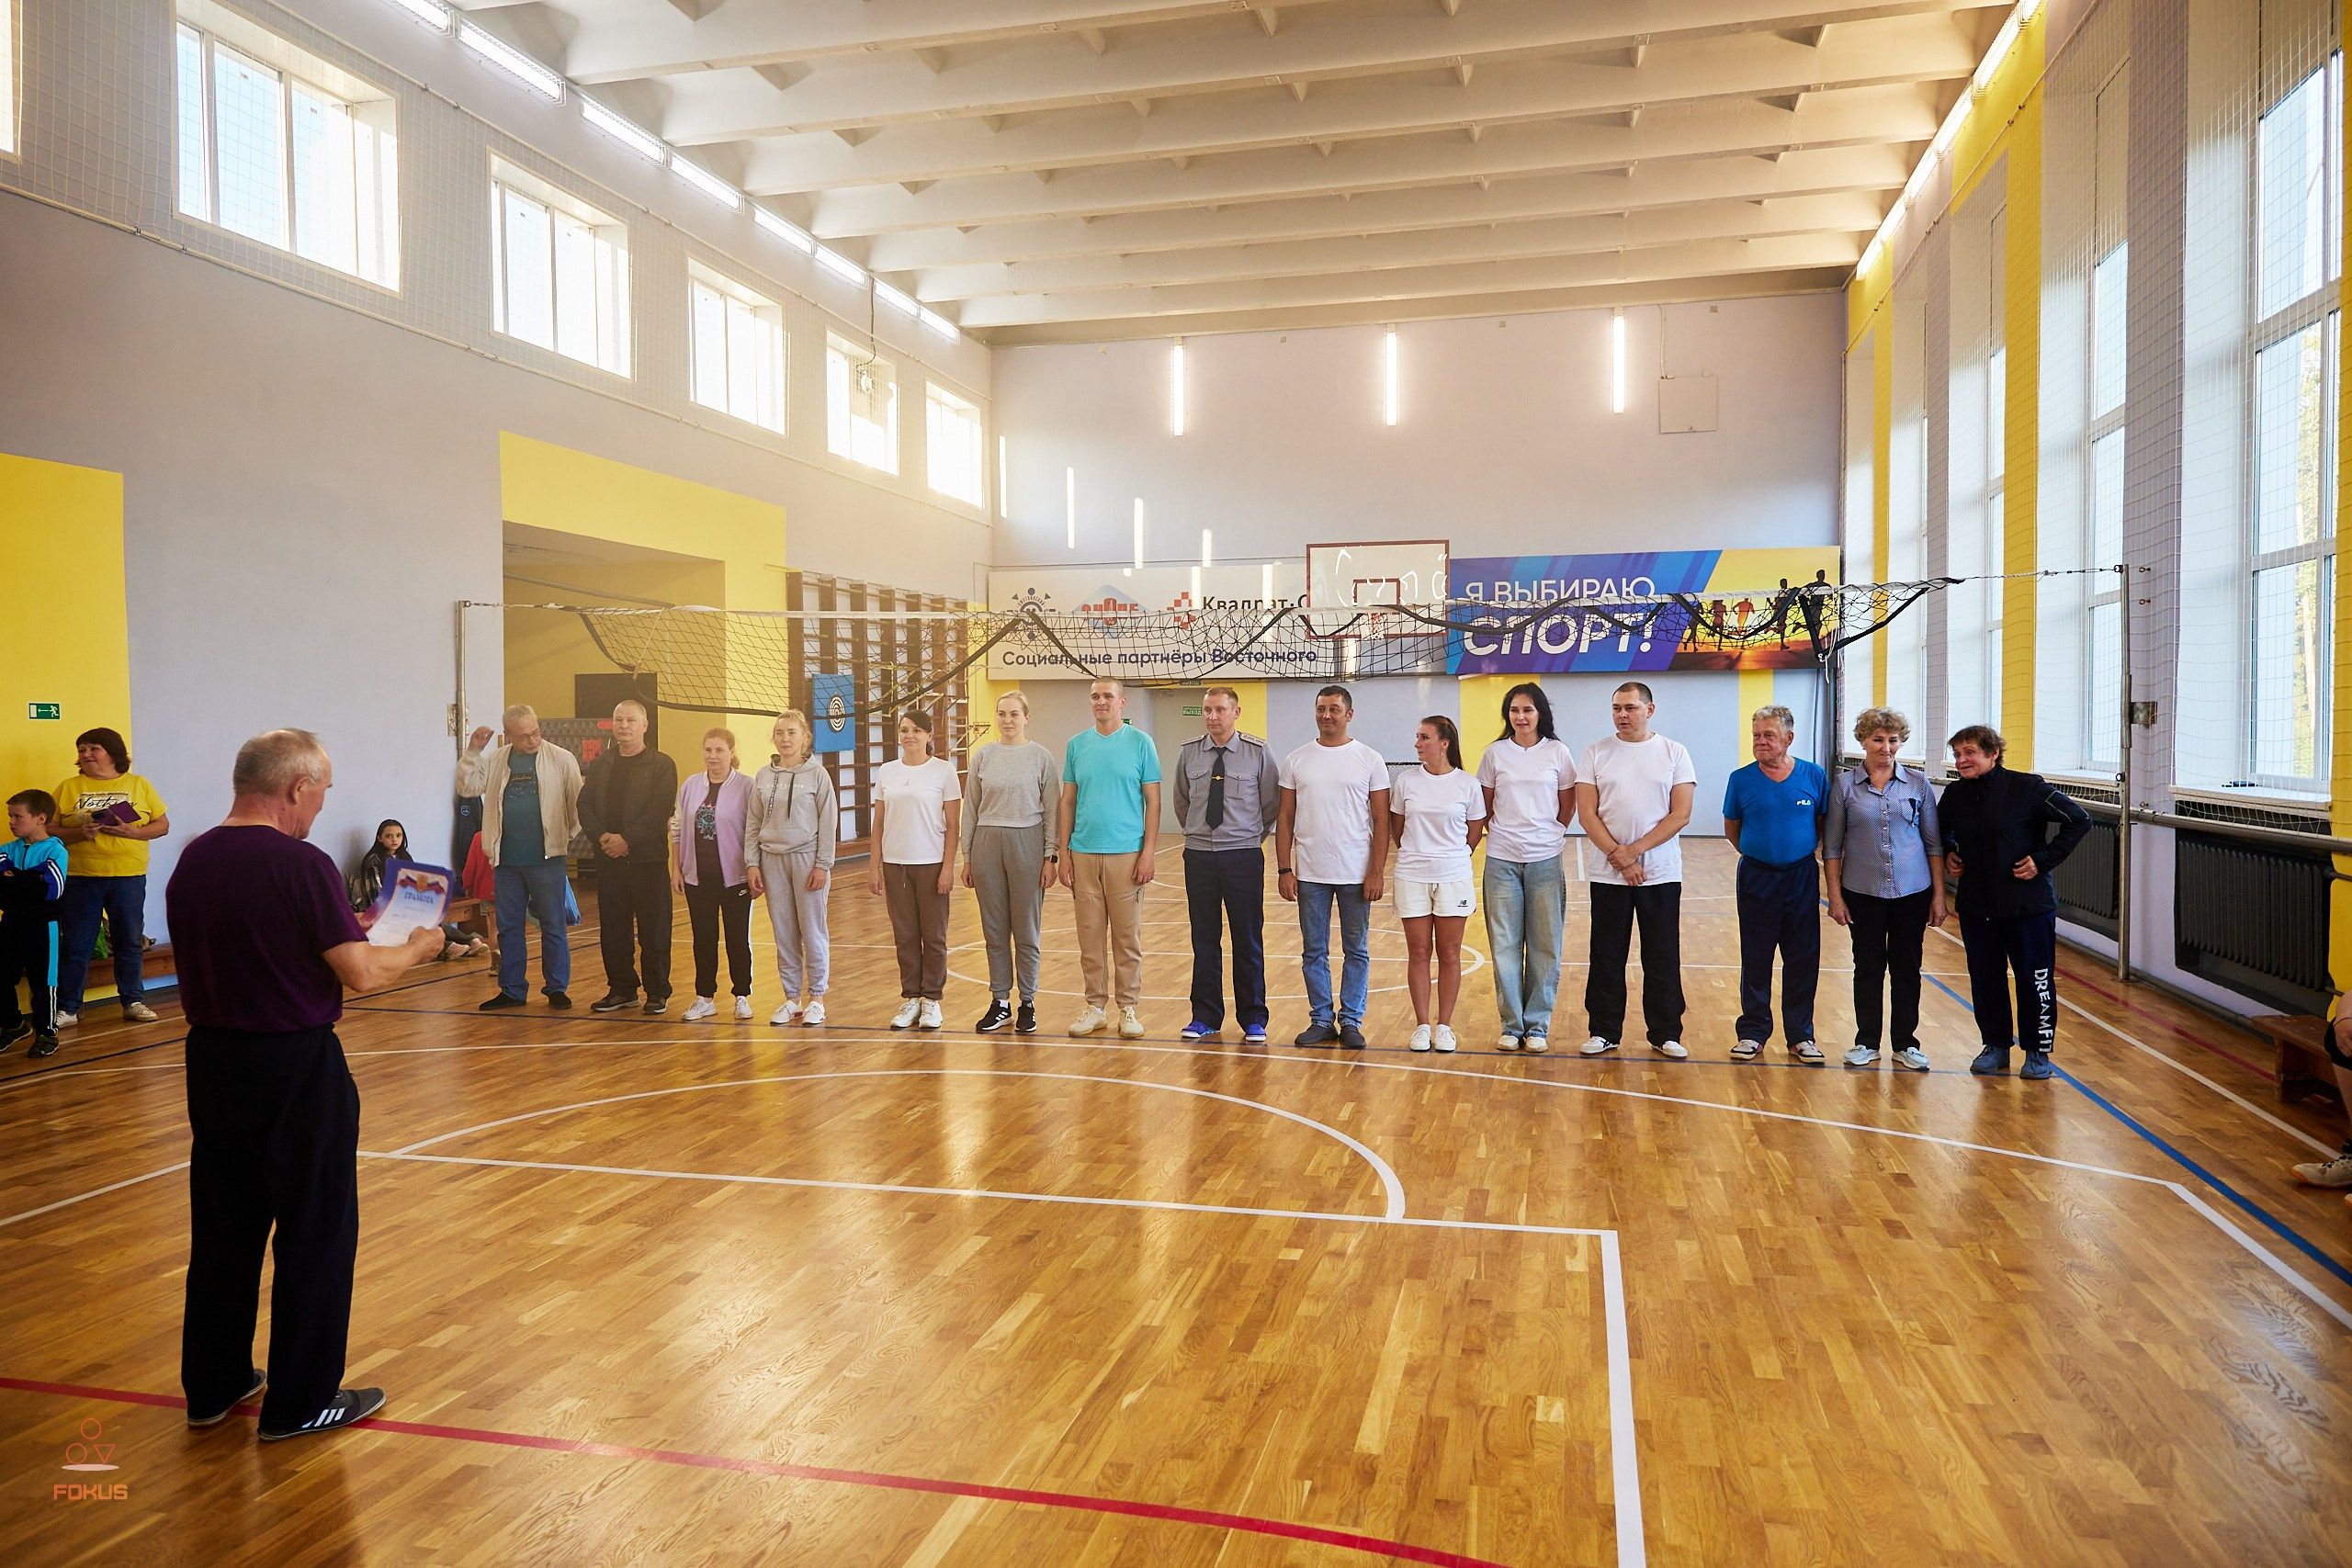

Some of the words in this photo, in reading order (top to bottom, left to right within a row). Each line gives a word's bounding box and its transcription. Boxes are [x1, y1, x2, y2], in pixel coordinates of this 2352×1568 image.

[1465, 581, 1484, 602] Я
[1494, 577, 1656, 602] ВЫБИРАЮ
[1464, 613, 1656, 656] СПОРТ!
[1117, 649, 1206, 667] партнёры
[1212, 649, 1317, 663] Восточного
